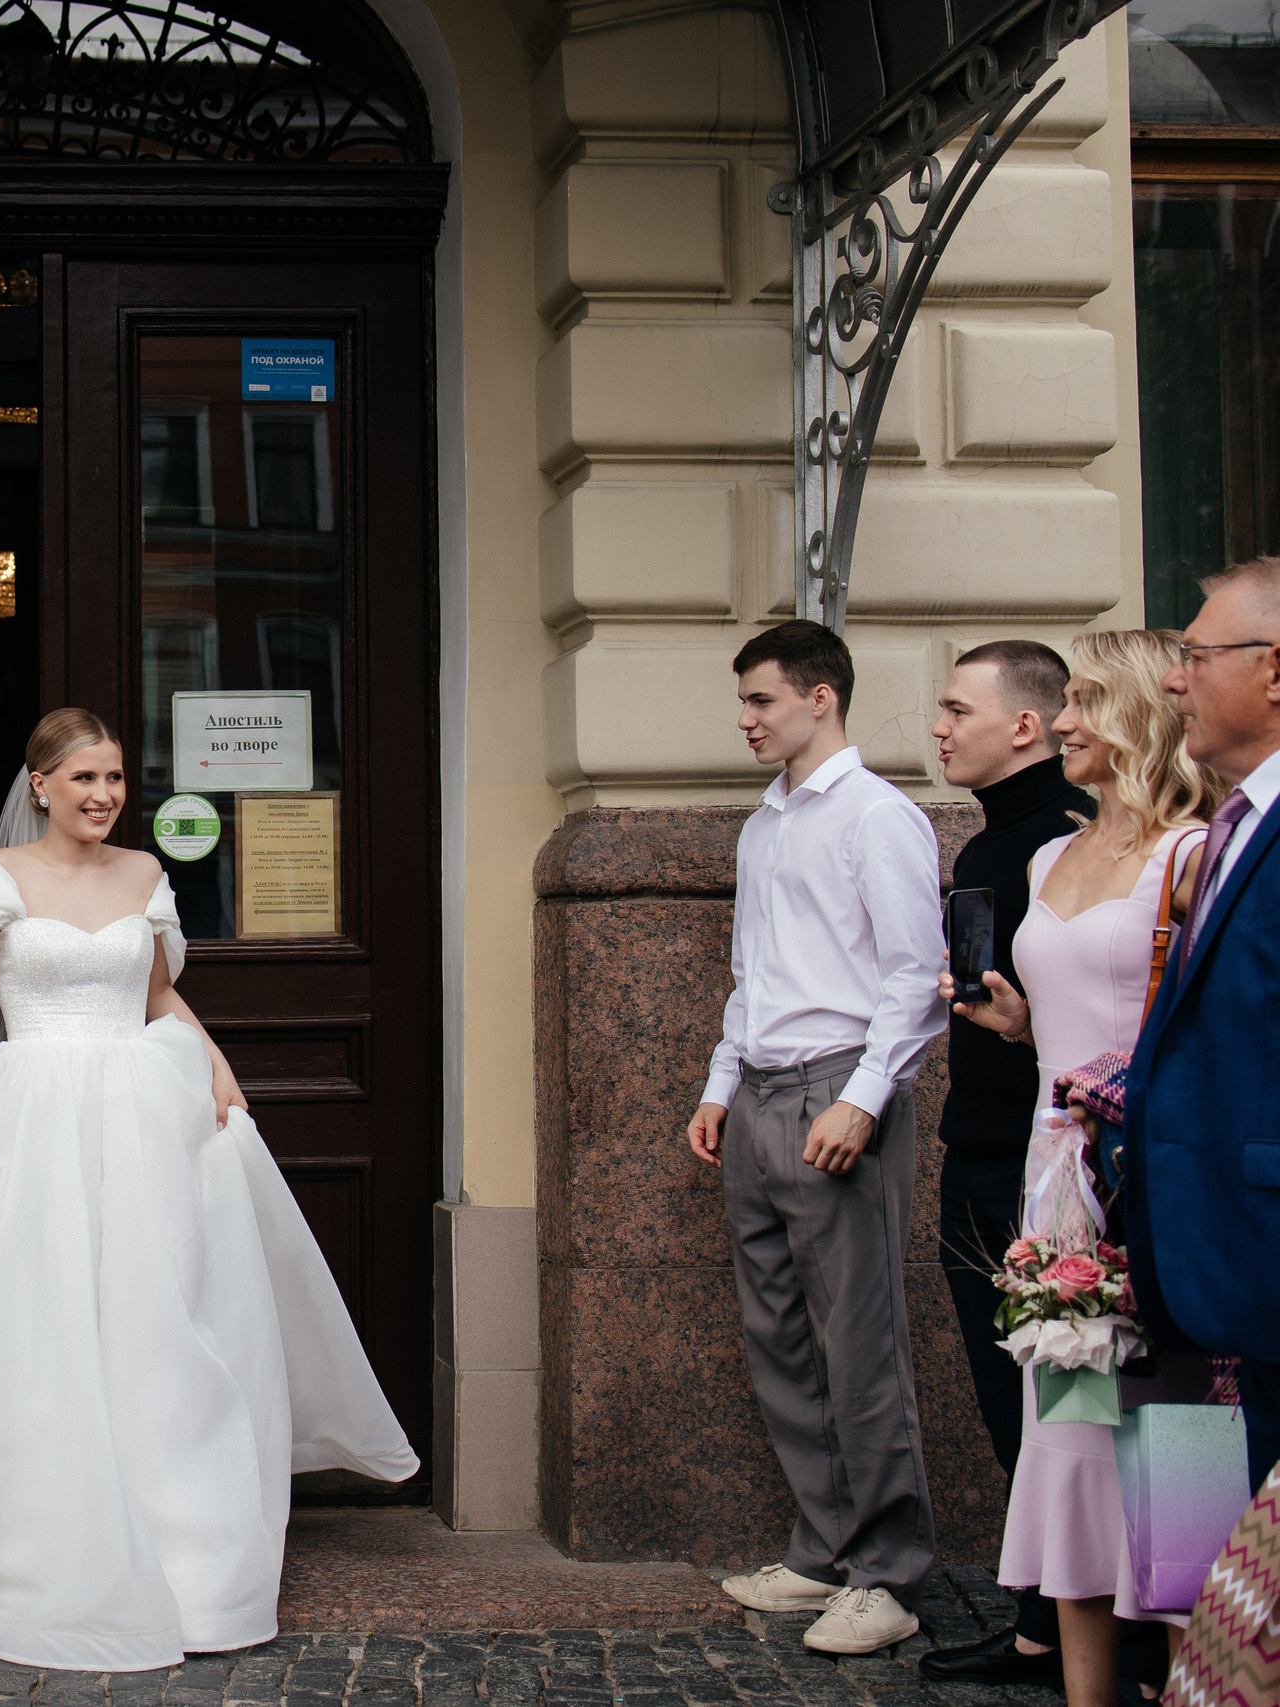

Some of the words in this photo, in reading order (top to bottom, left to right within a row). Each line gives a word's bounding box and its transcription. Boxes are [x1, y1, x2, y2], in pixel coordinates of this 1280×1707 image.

[251, 356, 274, 365] ПОД
[275, 355, 324, 365] ОХРАНОЙ
[205, 714, 282, 727] Апостиль
[211, 741, 229, 752] во
[233, 740, 279, 754] дворе
[160, 797, 188, 817] УЧАСТНИК
[190, 798, 213, 817] ПРОЕКТА
